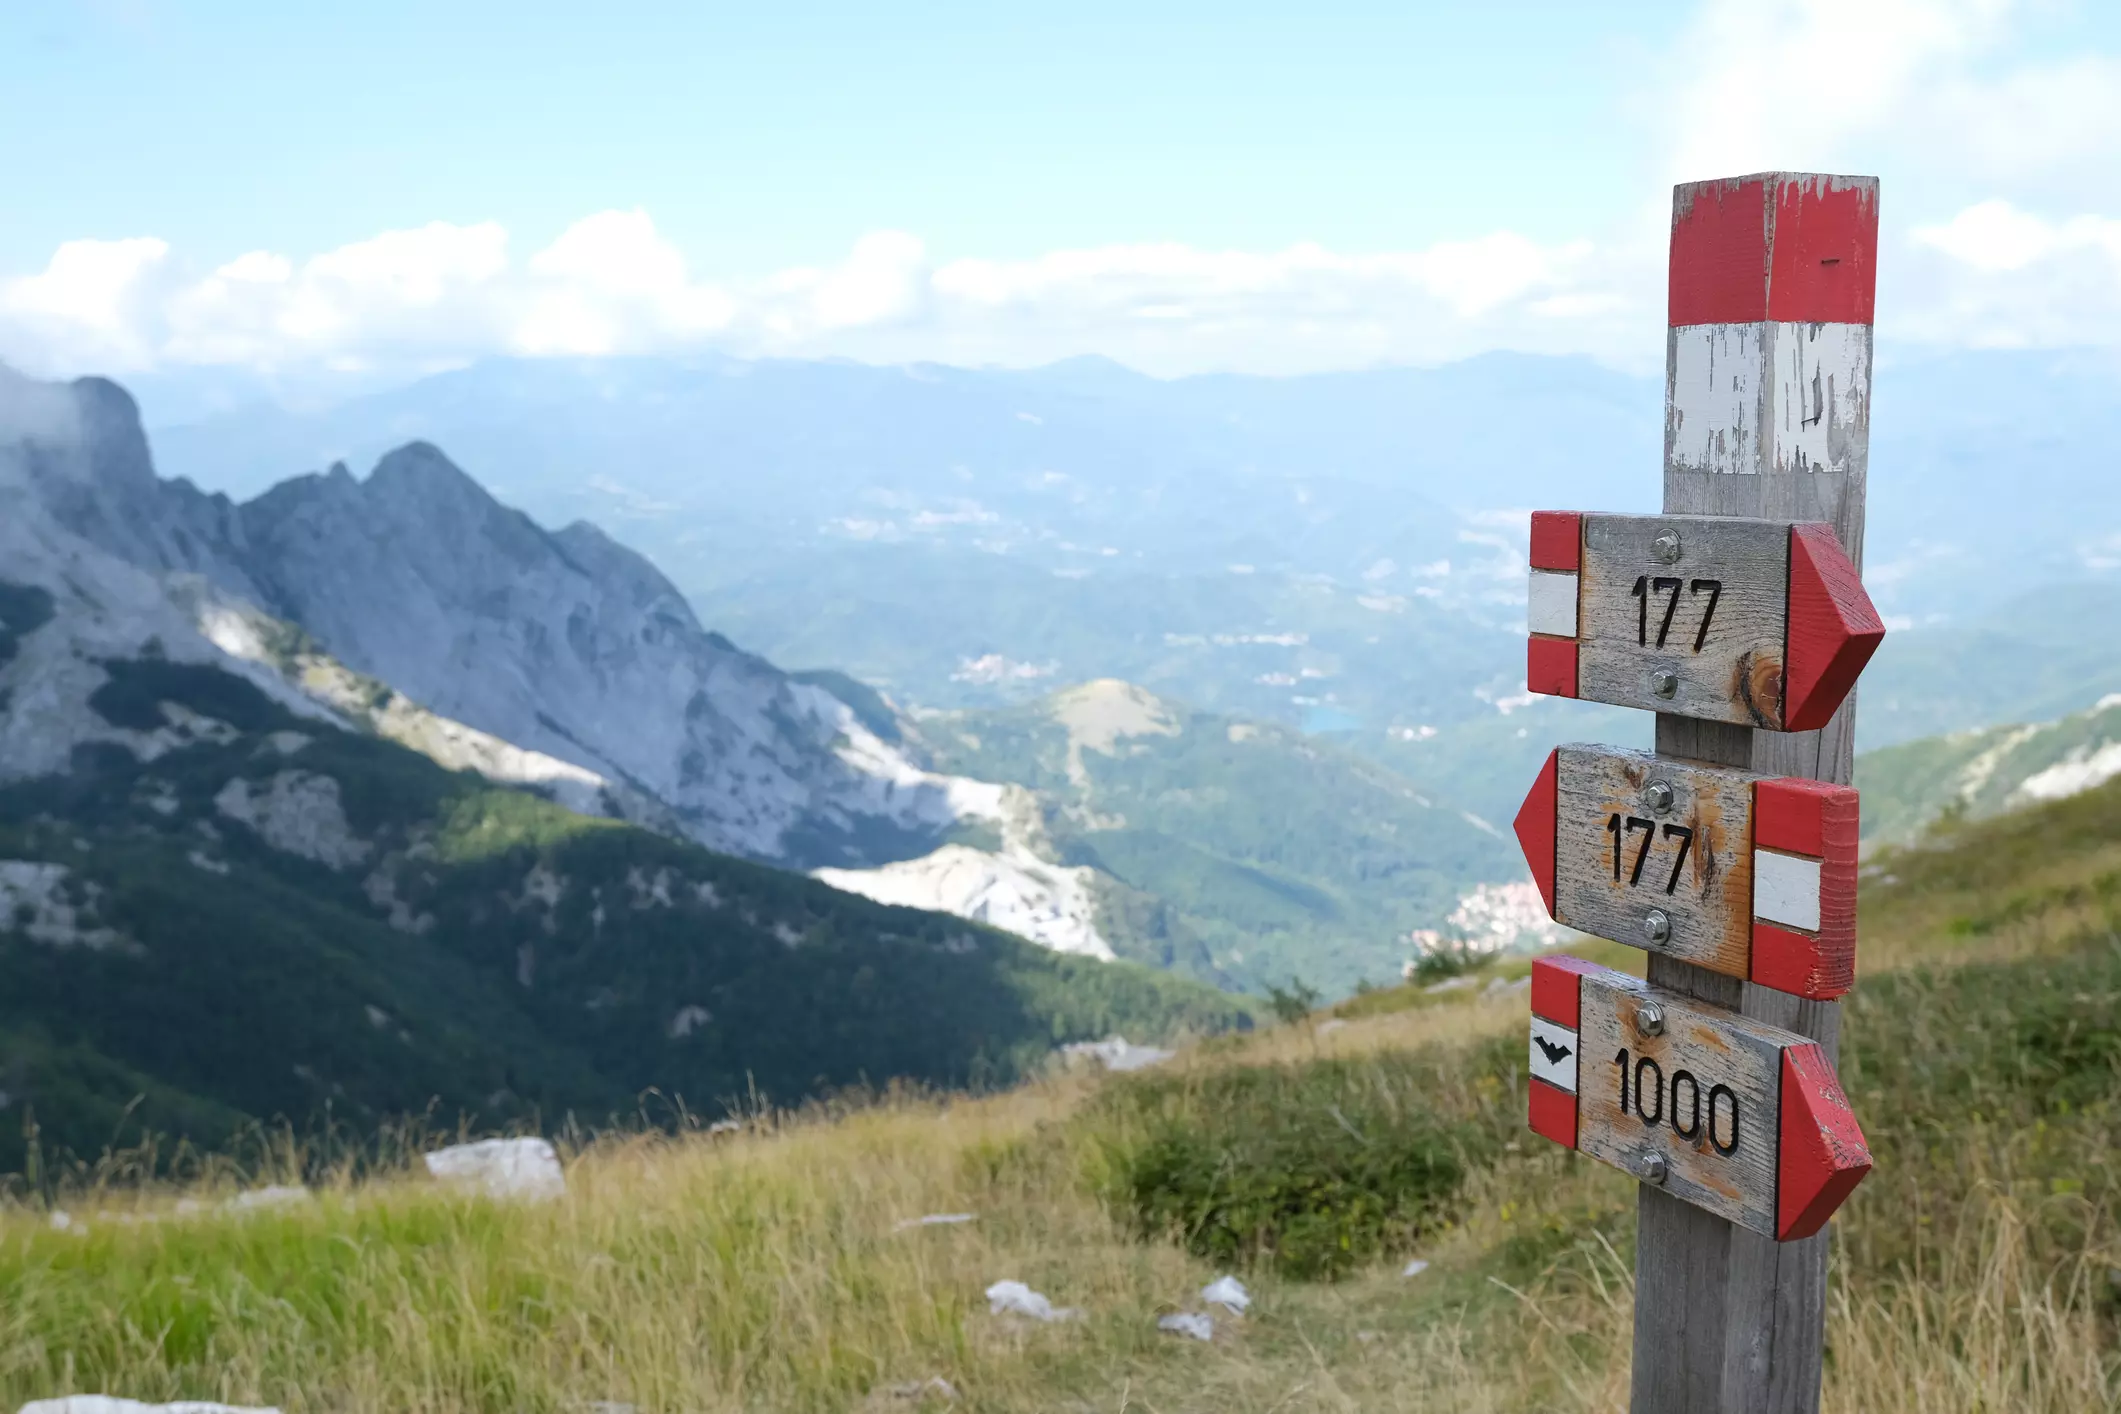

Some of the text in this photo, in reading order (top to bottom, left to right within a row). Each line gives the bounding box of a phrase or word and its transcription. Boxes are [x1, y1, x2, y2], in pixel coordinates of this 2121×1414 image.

[1631, 576, 1722, 654] 177
[1607, 813, 1693, 896] 177
[1615, 1048, 1739, 1157] 1000
